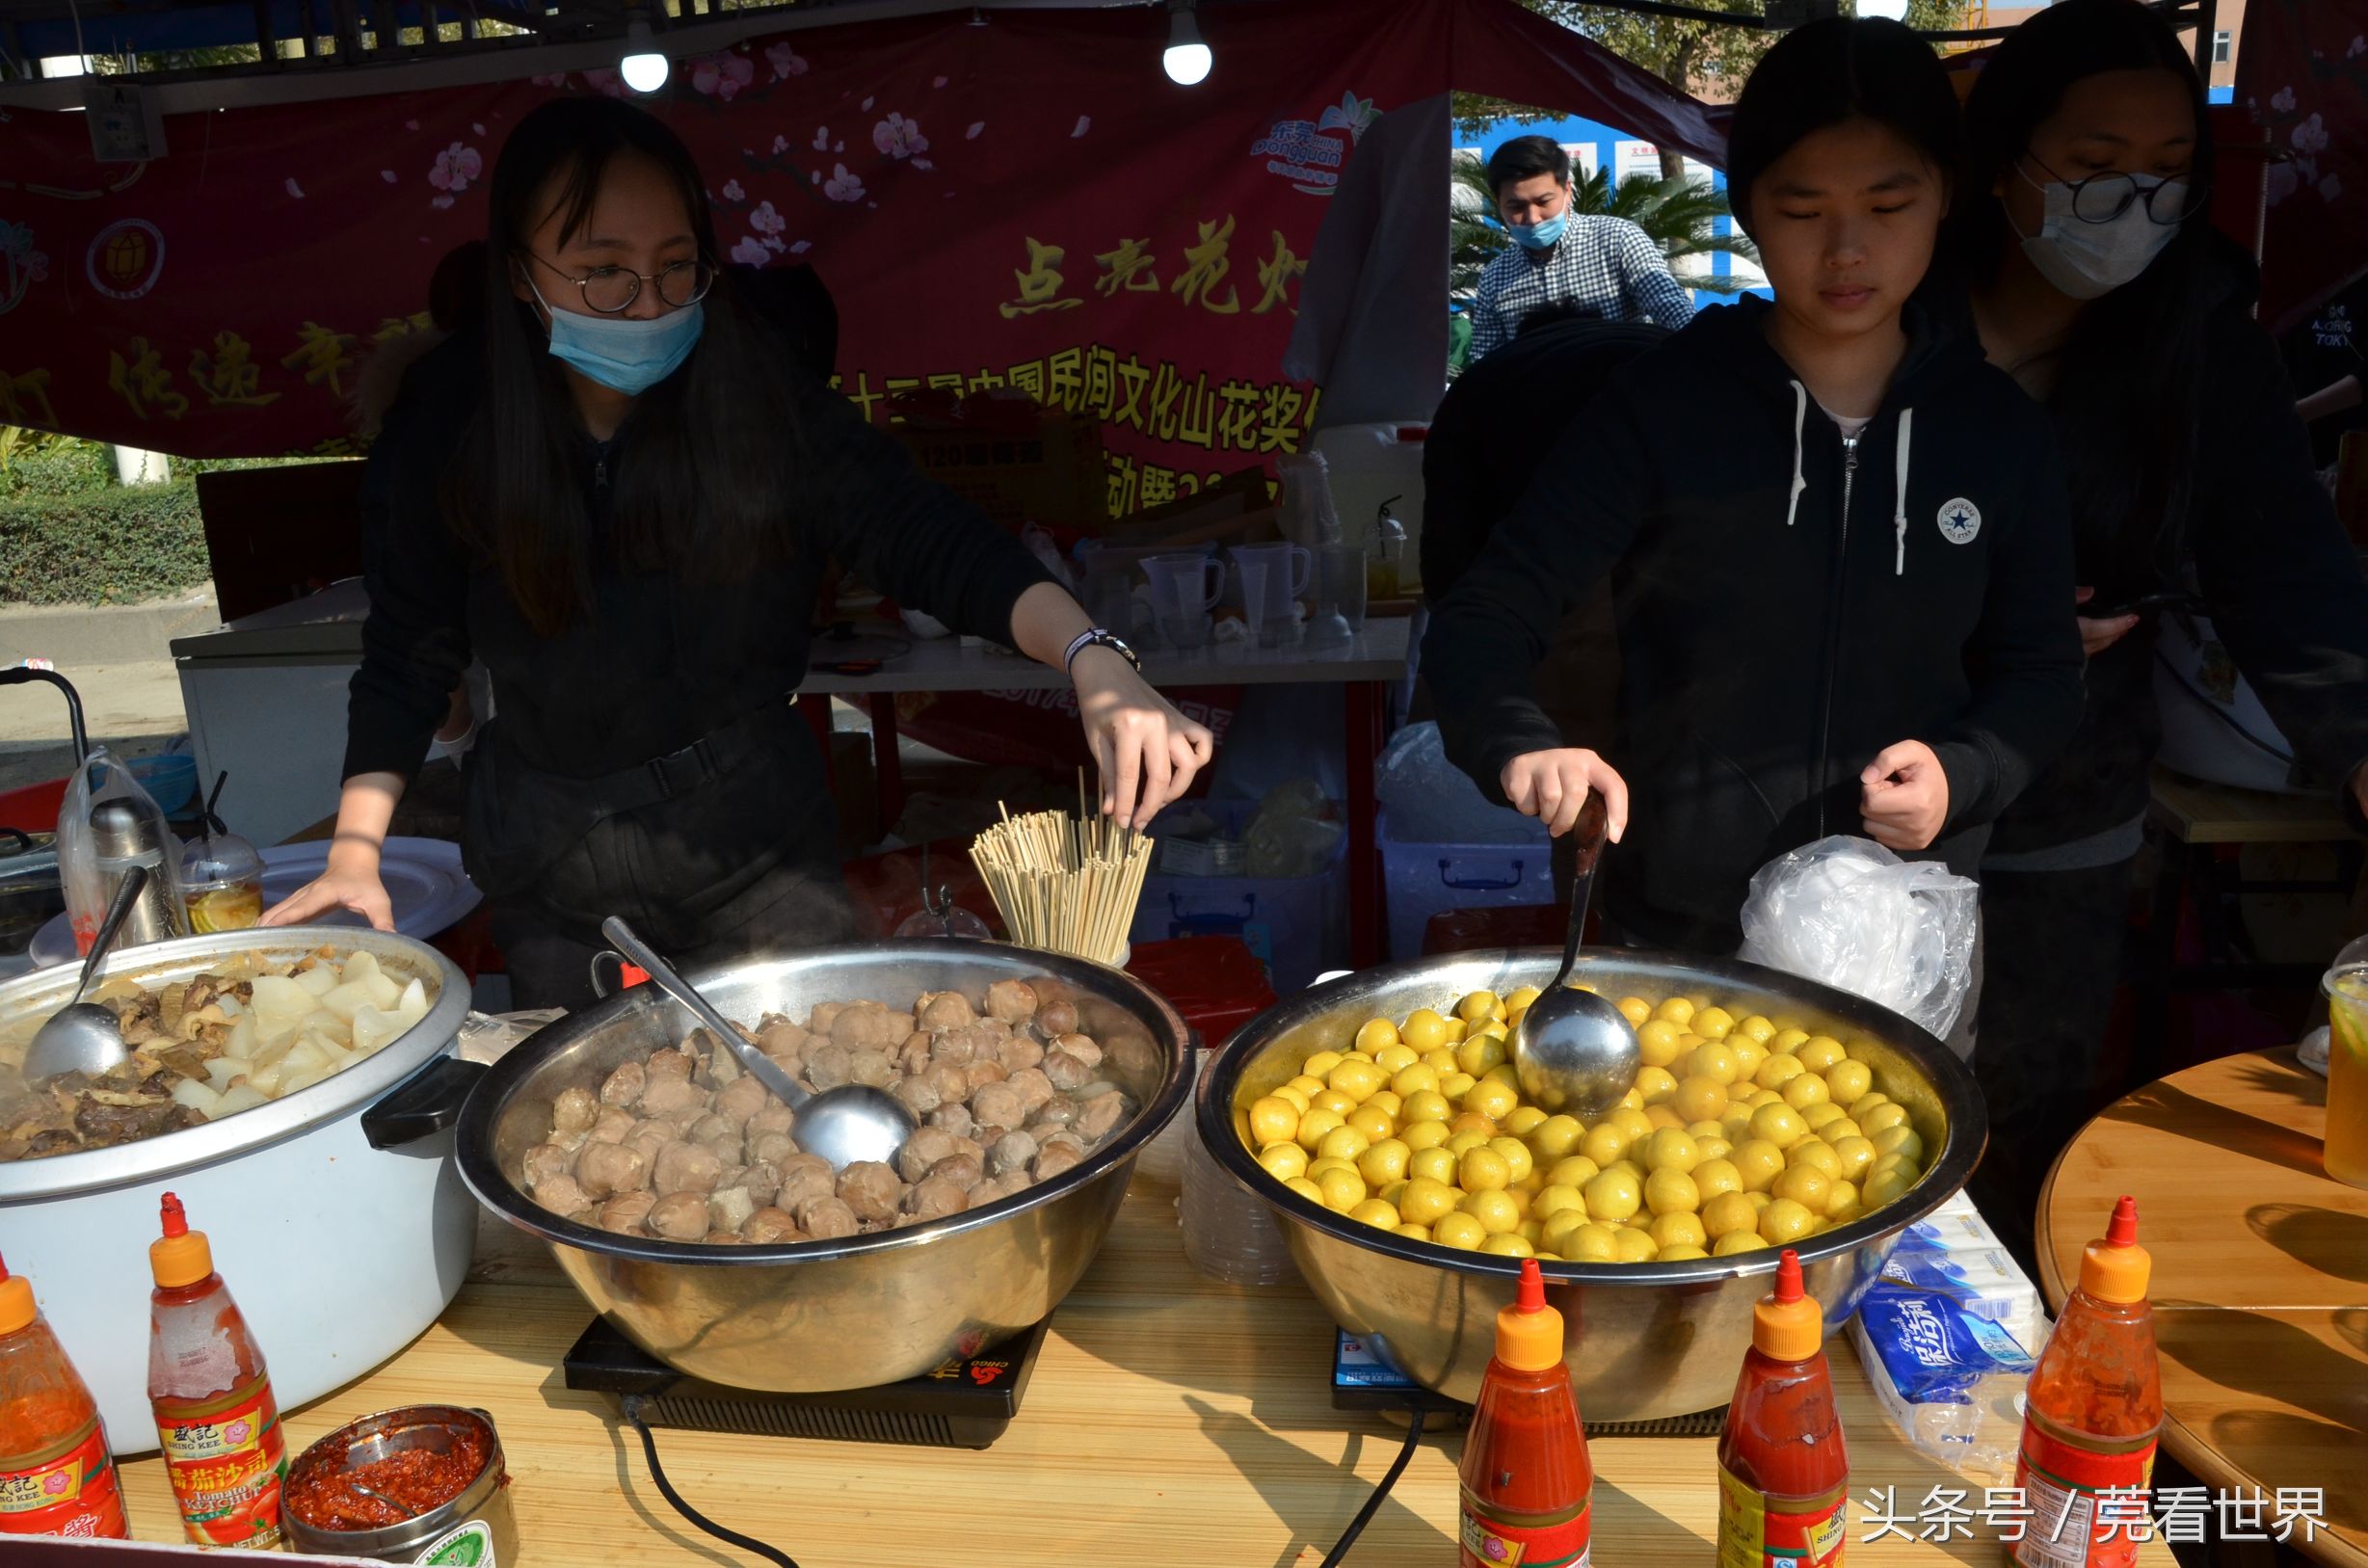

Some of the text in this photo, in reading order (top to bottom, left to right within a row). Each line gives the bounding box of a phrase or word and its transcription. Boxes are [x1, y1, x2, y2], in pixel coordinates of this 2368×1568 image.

[1271, 120, 1317, 145] 东莞
[1251, 141, 1343, 167] Dongguan
[108, 310, 432, 421] 传递幸
[199, 1440, 221, 1449] KEE
[172, 1449, 268, 1491] 番茄沙司
[16, 1492, 40, 1502] KEE
[184, 1487, 262, 1509] KETCHUP
[194, 1485, 247, 1502] Tomato
